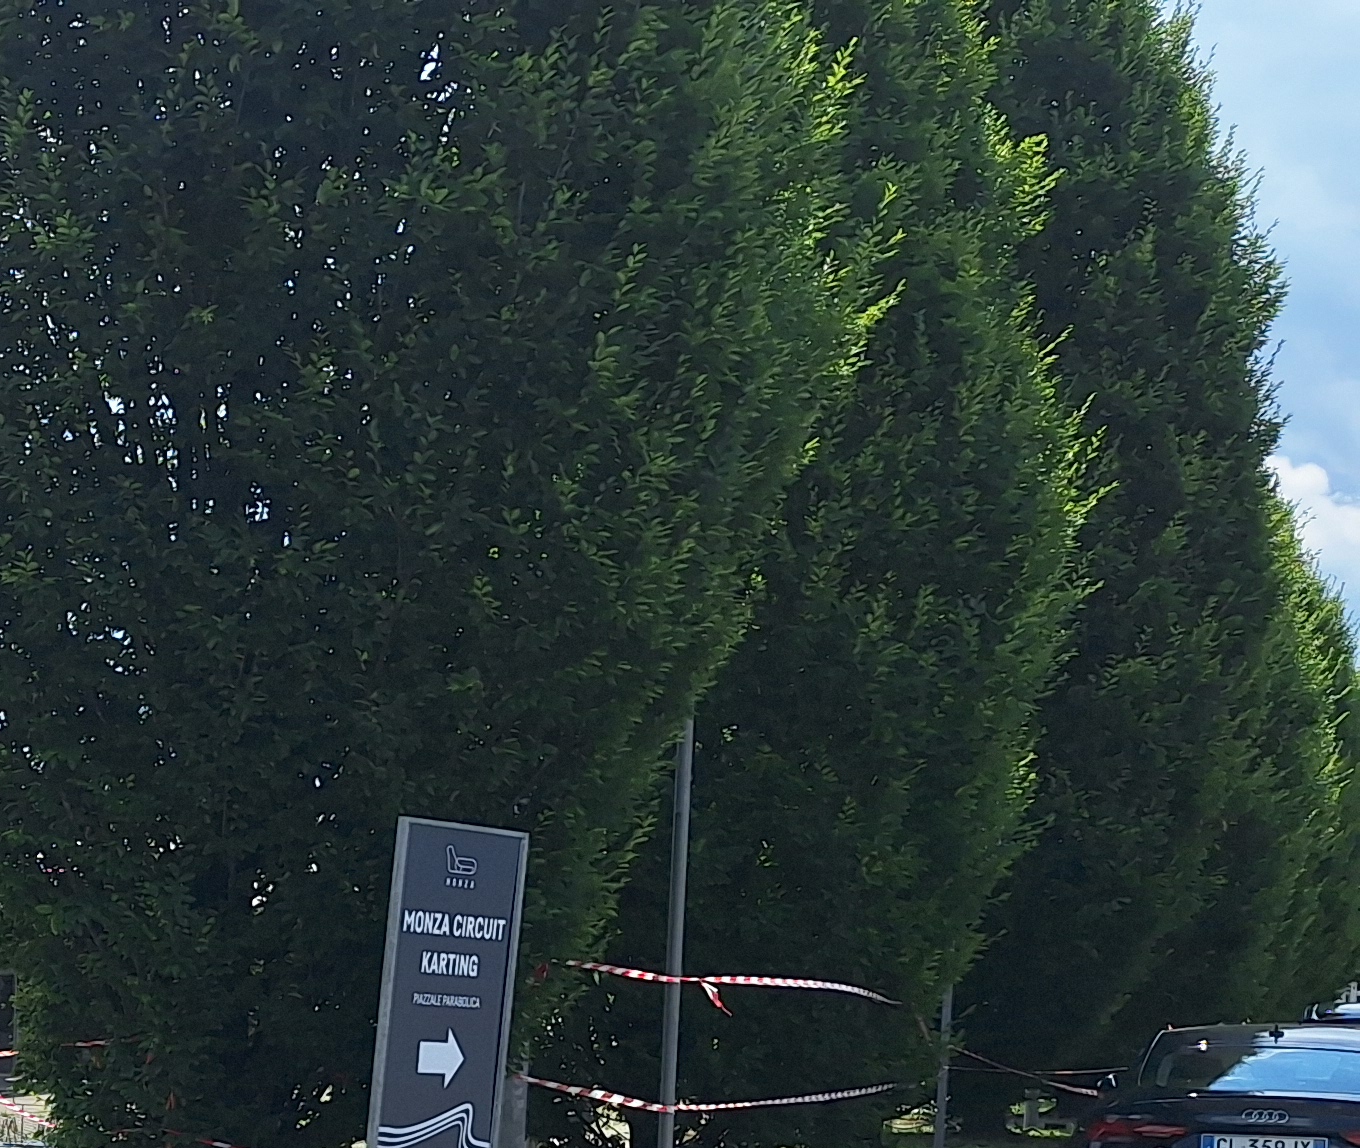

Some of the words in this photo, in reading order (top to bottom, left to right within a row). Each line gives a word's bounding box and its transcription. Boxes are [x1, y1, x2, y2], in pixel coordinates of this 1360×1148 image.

[402, 910, 450, 936] MONZA
[453, 914, 507, 941] CIRCUIT
[421, 951, 479, 977] KARTING
[413, 993, 442, 1006] PIAZZALE
